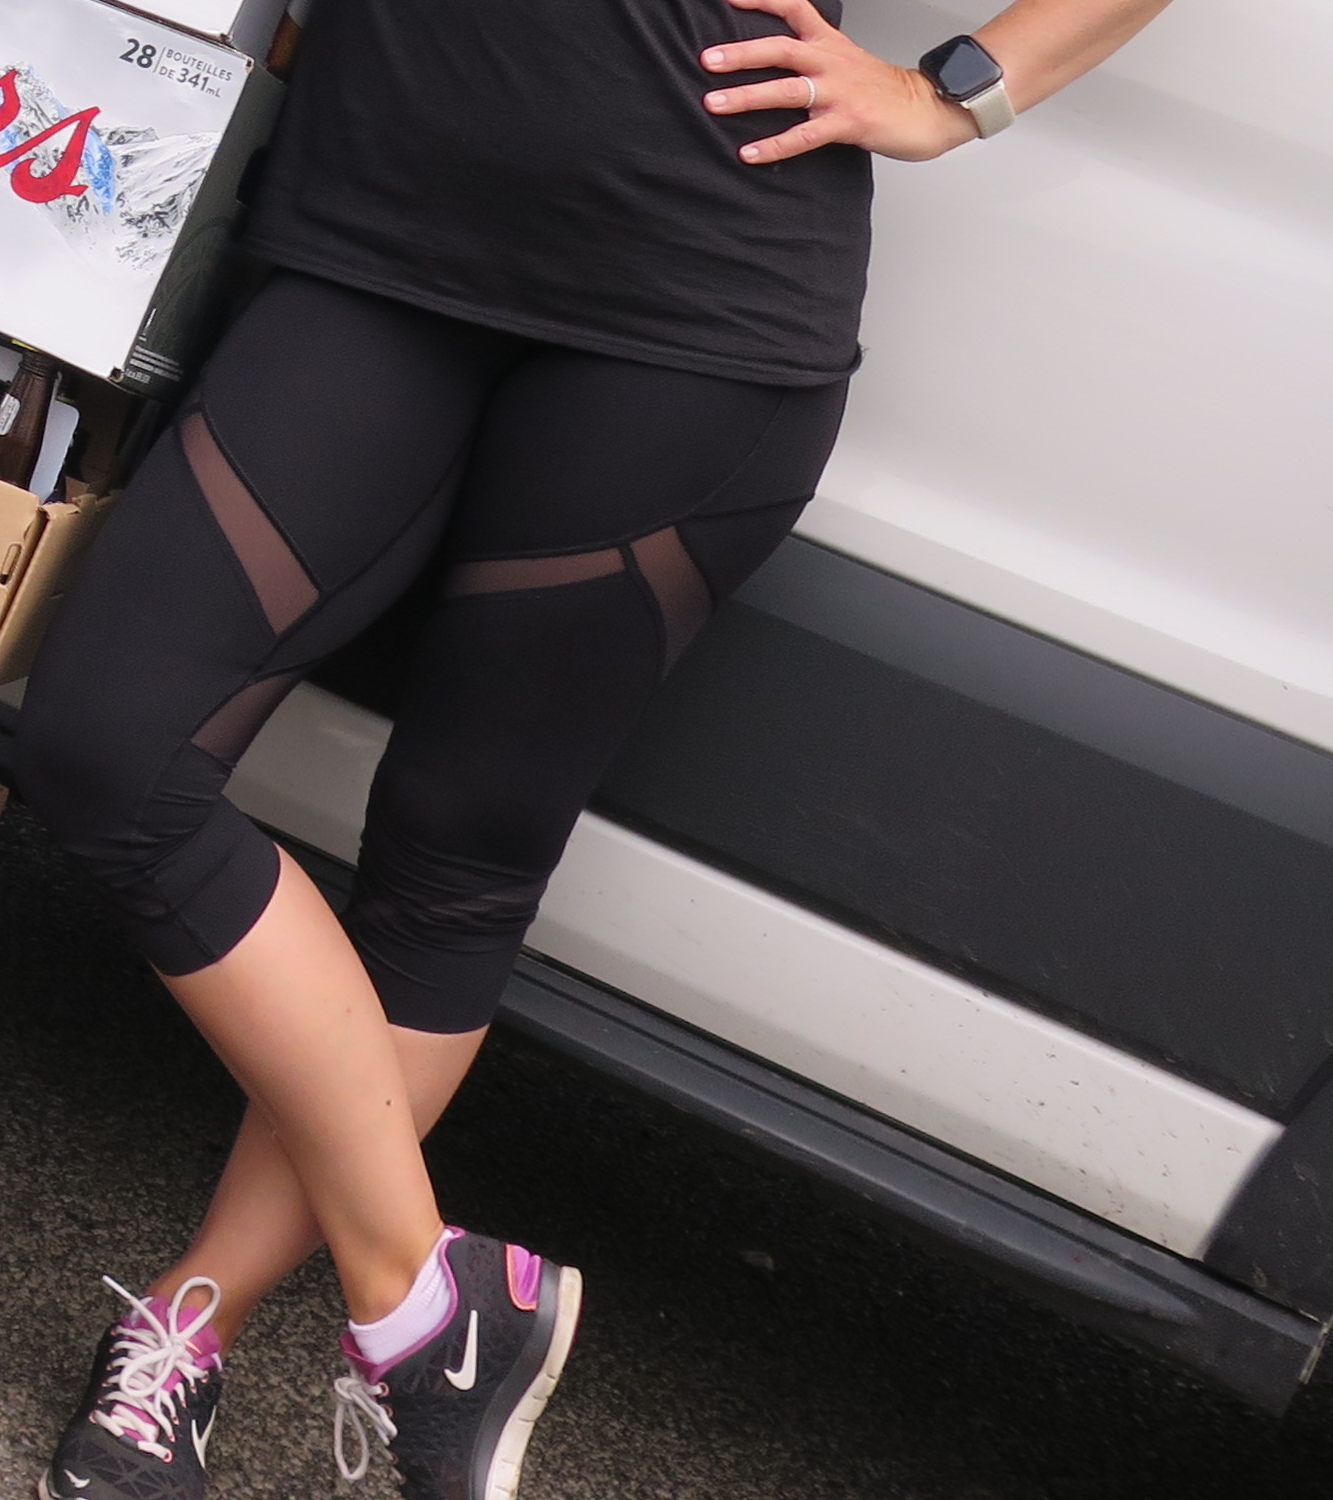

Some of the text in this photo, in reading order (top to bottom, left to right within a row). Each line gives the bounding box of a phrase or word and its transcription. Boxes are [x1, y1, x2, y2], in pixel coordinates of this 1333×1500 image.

[118, 37, 233, 82] 28 BOUTEILLES
[158, 65, 176, 80] DE
